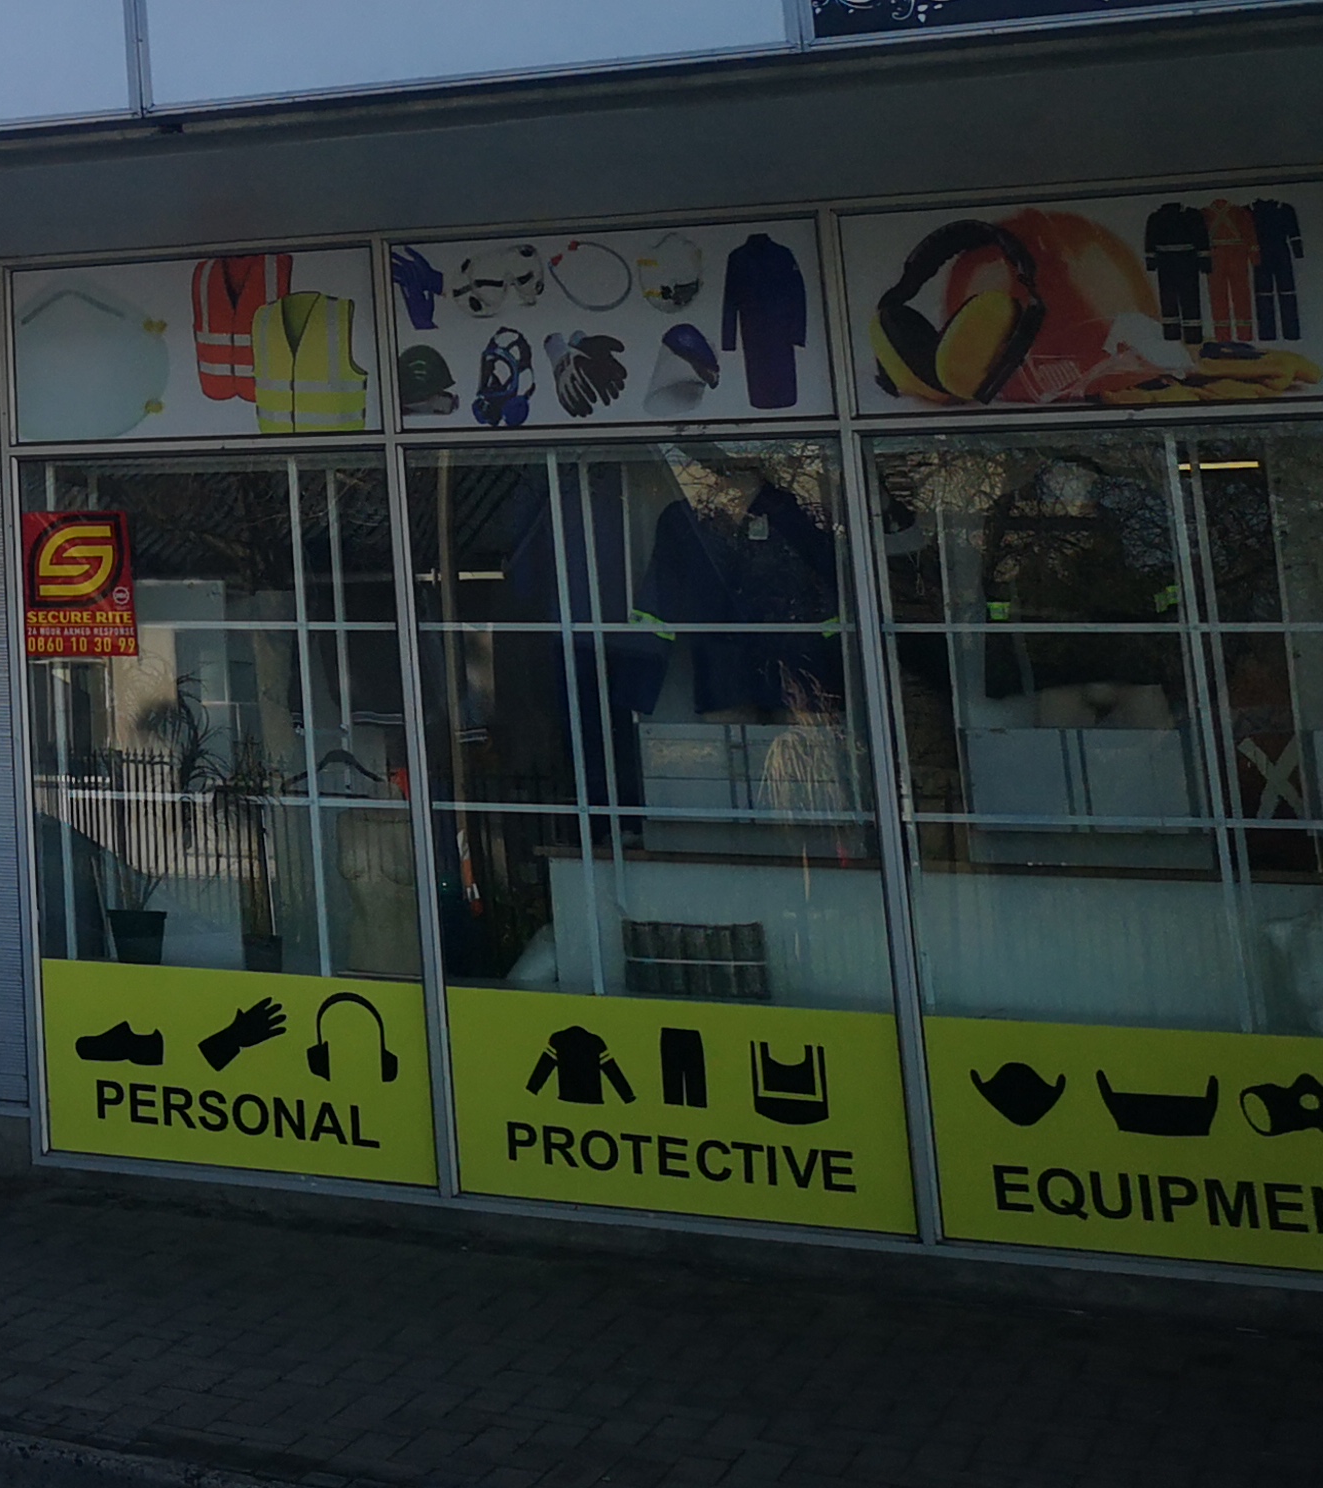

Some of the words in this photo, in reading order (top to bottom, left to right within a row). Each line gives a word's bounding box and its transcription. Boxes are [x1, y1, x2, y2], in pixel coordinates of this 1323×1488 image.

[26, 611, 93, 624] SECURE
[95, 611, 133, 624] RITE
[63, 626, 92, 636] ARMED
[93, 626, 135, 637] RESPONSE
[28, 637, 64, 653] 0860
[71, 636, 88, 653] 10
[94, 636, 112, 653] 30
[118, 636, 137, 653] 99
[96, 1079, 381, 1149] PERSONAL
[506, 1121, 857, 1193] PROTECTIVE
[992, 1163, 1323, 1235] EQUIPME
